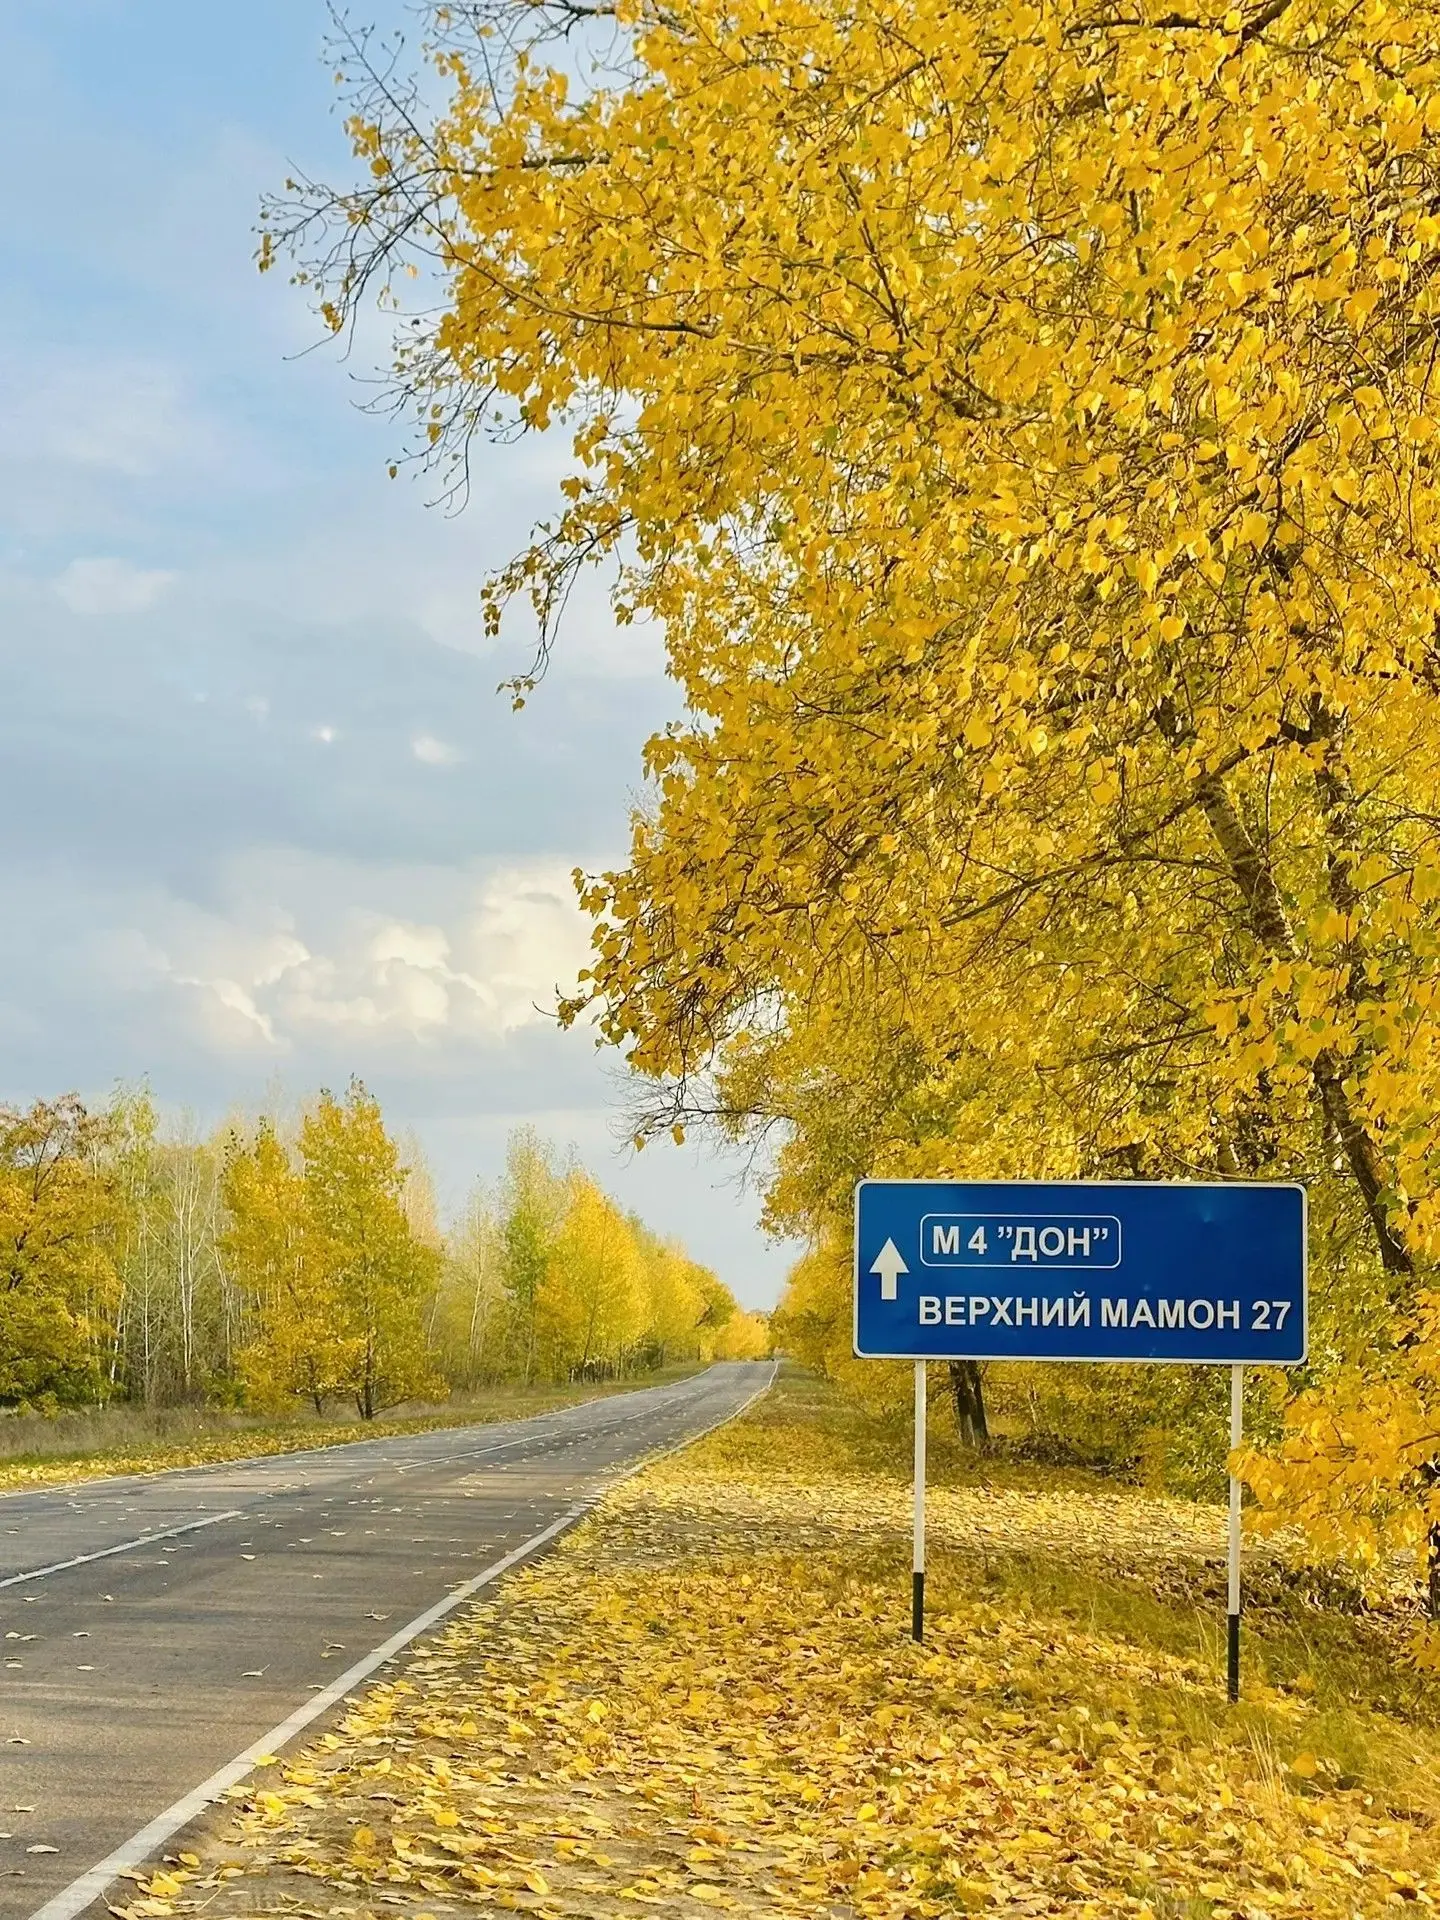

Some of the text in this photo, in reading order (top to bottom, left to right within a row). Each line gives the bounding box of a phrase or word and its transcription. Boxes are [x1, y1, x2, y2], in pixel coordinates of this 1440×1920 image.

[932, 1225, 960, 1255] М
[967, 1226, 988, 1255] 4
[918, 1290, 1292, 1331] ВЕРХНИЙ МАМОН 27
